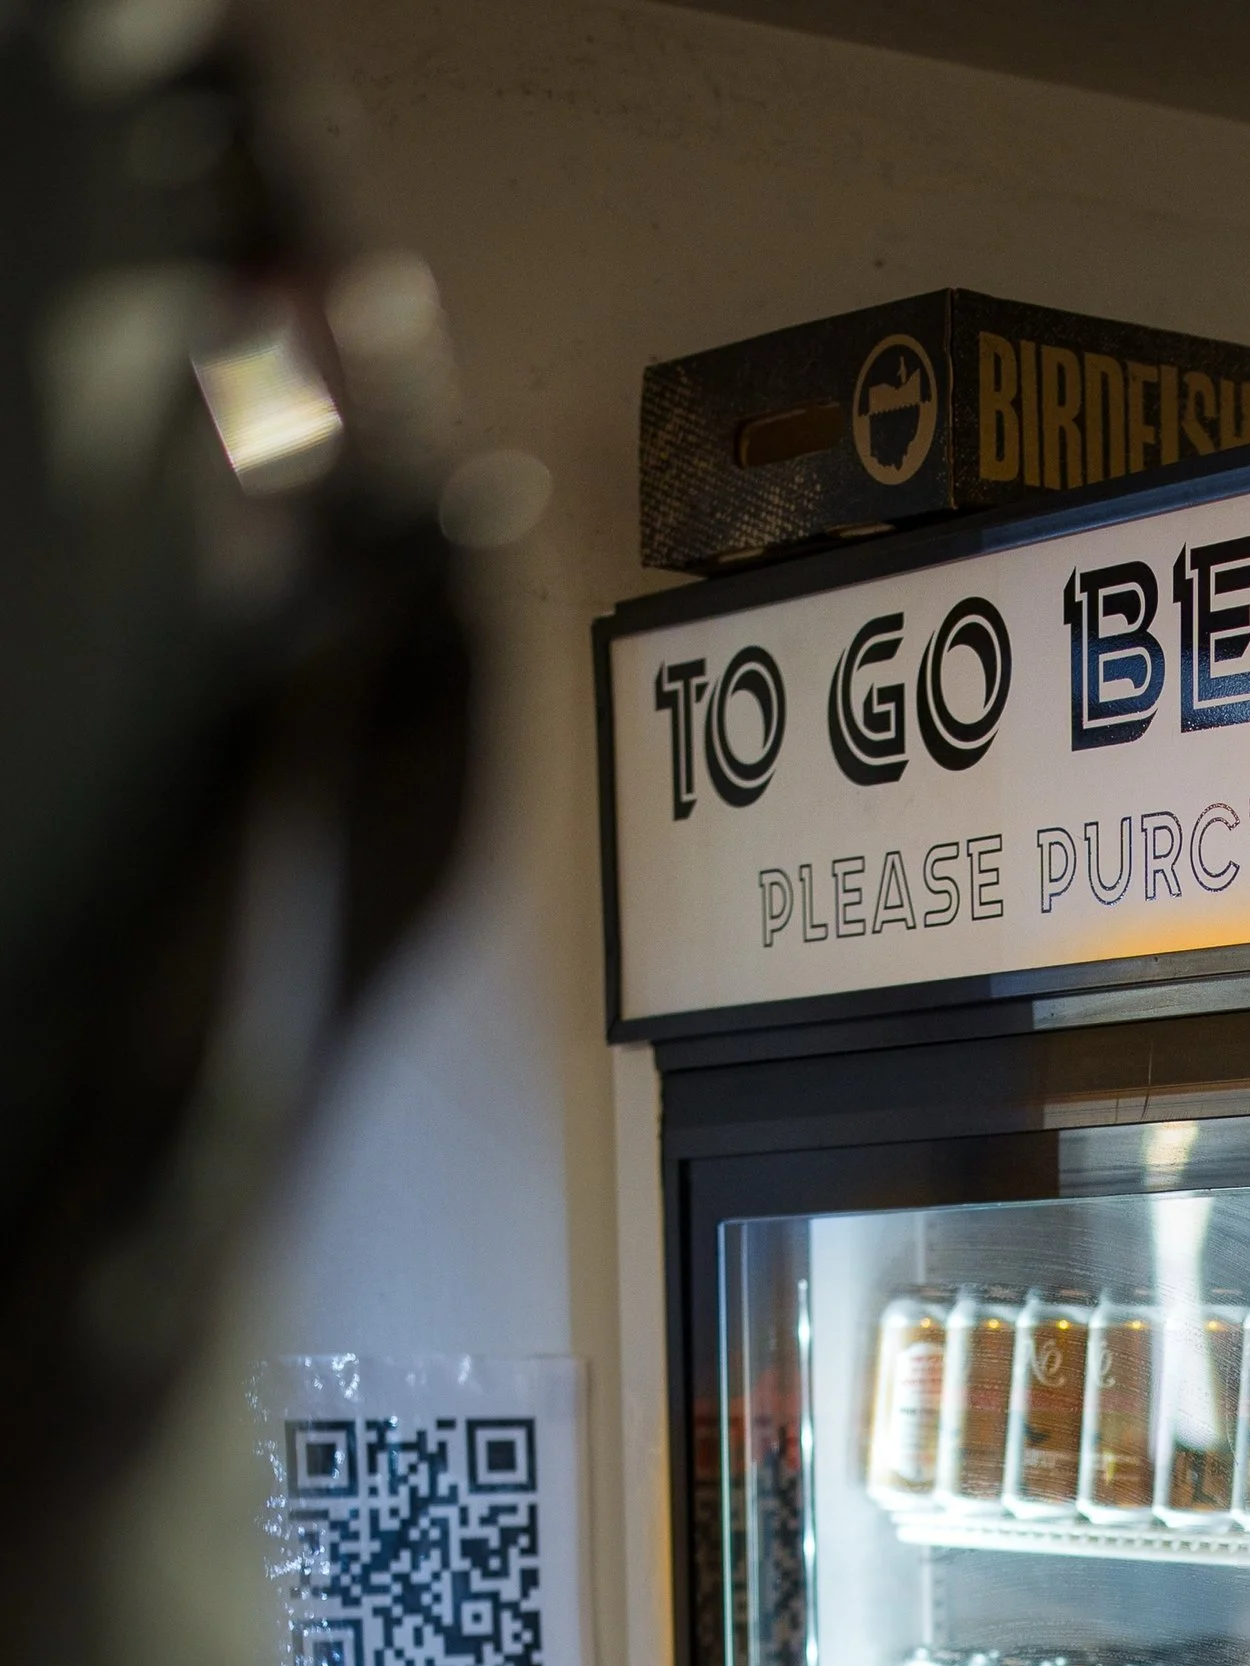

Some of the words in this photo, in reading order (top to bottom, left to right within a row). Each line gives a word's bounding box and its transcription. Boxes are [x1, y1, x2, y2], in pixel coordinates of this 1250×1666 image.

[656, 645, 787, 821] TO
[828, 596, 1012, 787] GO
[759, 834, 1003, 948] PLEASE
